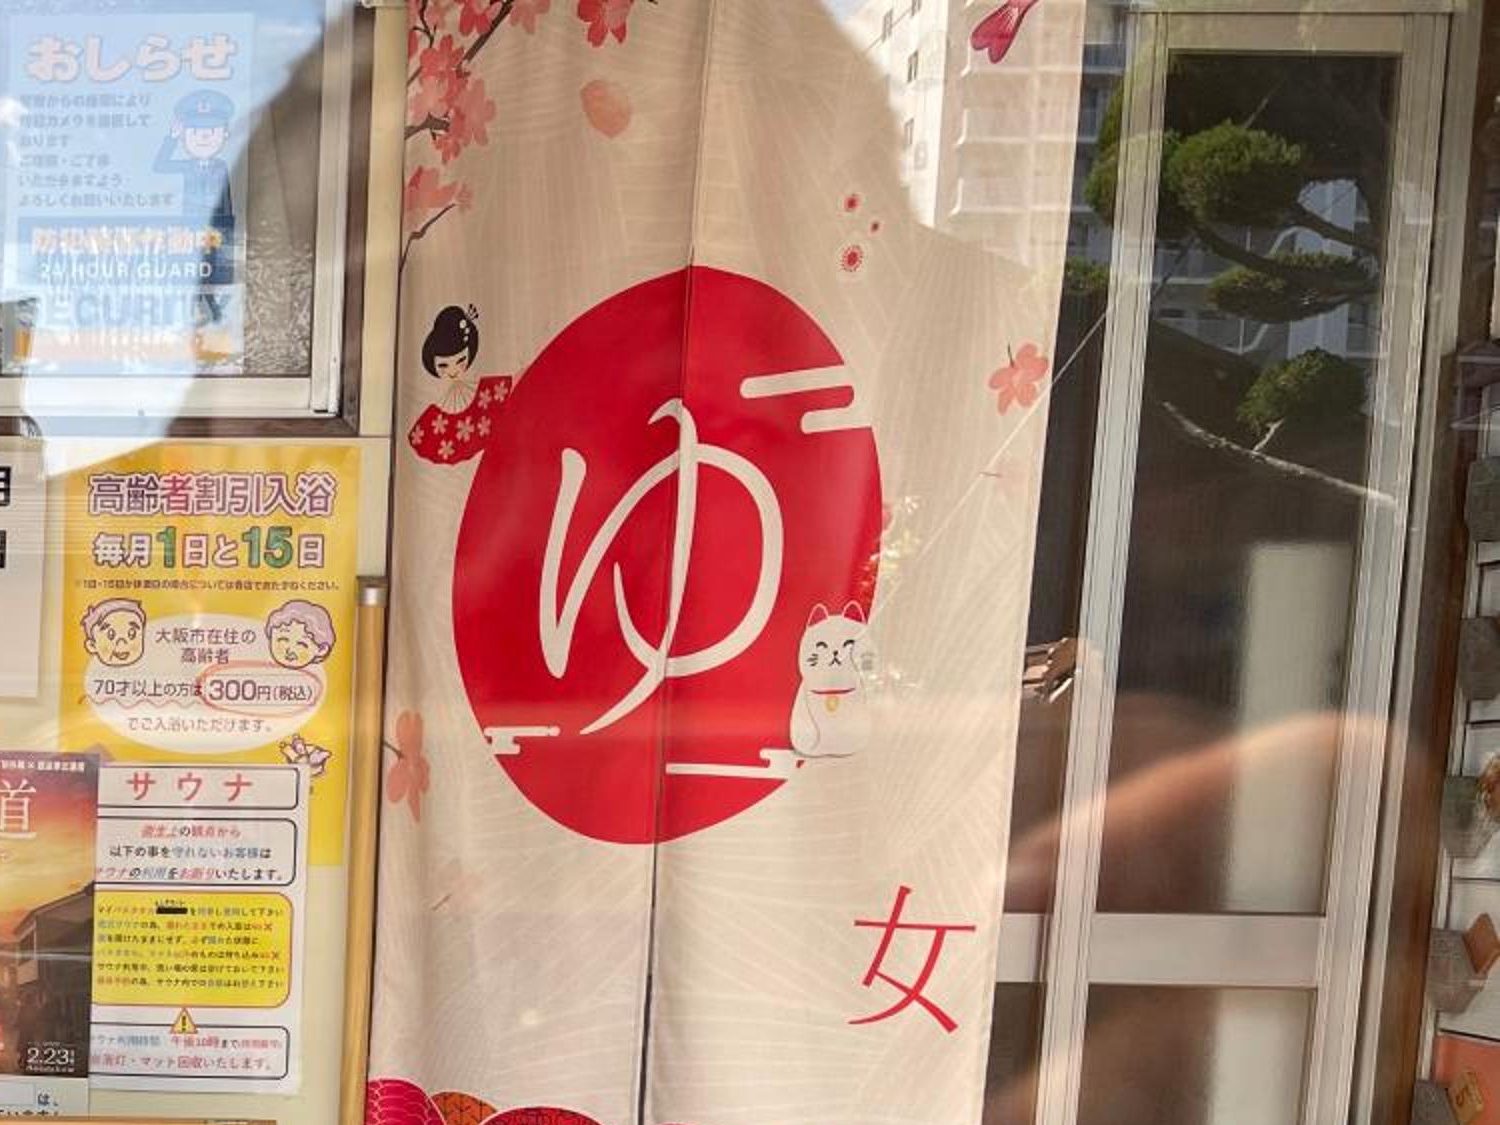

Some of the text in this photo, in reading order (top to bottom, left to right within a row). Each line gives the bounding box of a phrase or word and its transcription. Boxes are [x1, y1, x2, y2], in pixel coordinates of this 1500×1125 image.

[26, 31, 238, 84] おしらせ
[72, 263, 129, 278] HOUR
[137, 262, 213, 278] GUARD
[88, 472, 338, 516] 高齢者割引入浴
[92, 526, 325, 569] 毎月1日と15日
[539, 398, 783, 734] ゆ
[155, 628, 257, 645] 大阪市在住の
[180, 648, 230, 665] 高齢者
[93, 678, 314, 702] 70才以上の方は 300円(税込)
[127, 717, 274, 734] でご入浴いただけます。
[126, 772, 252, 801] サウナ
[848, 885, 977, 1034] 女
[26, 1047, 70, 1065] 2.23
